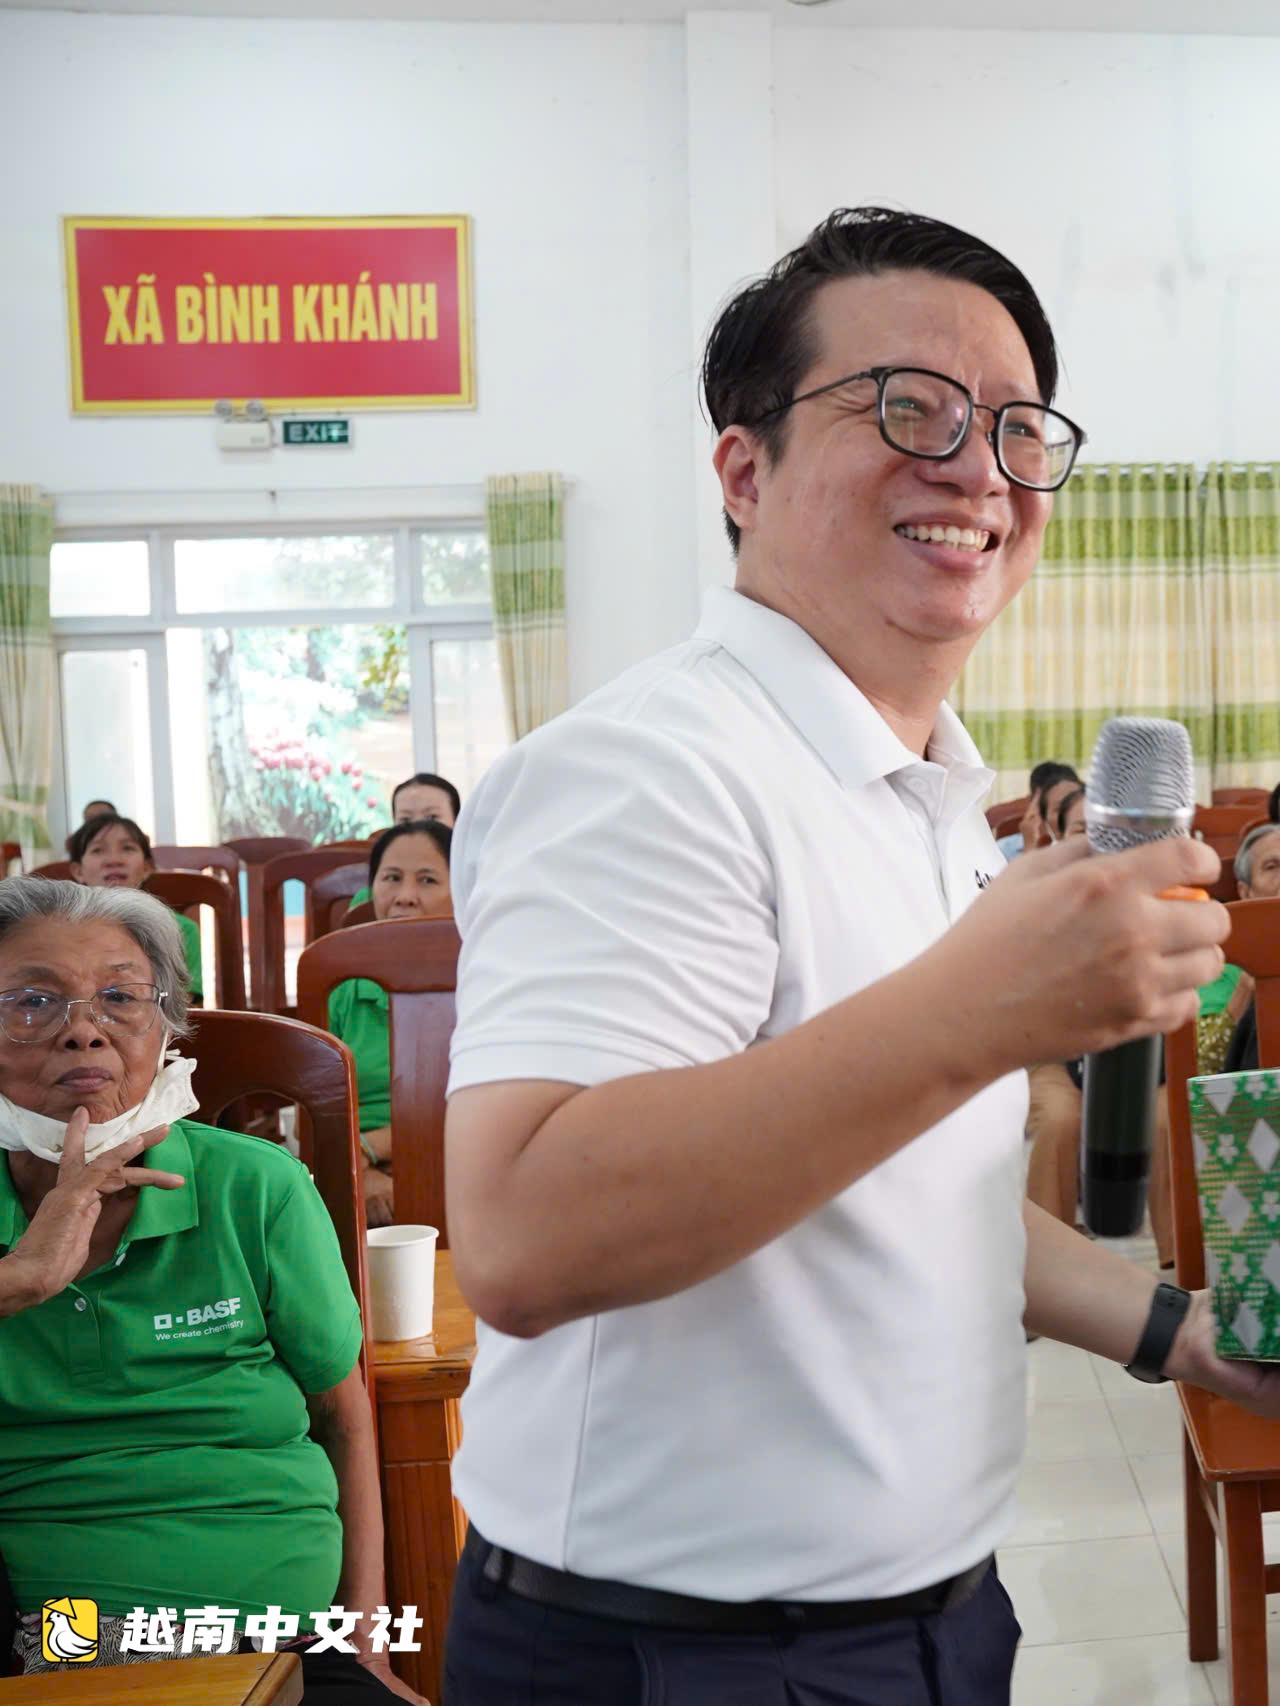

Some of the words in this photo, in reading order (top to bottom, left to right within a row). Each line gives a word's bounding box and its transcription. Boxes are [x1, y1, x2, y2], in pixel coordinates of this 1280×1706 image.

[103, 273, 165, 345] XÃ
[176, 271, 281, 345] BÌNH
[293, 270, 439, 343] KHÁNH
[289, 422, 343, 442] EXIT
[186, 1297, 241, 1327] BASF
[155, 1332, 171, 1341] We
[172, 1329, 202, 1340] create
[203, 1319, 244, 1336] chemistry
